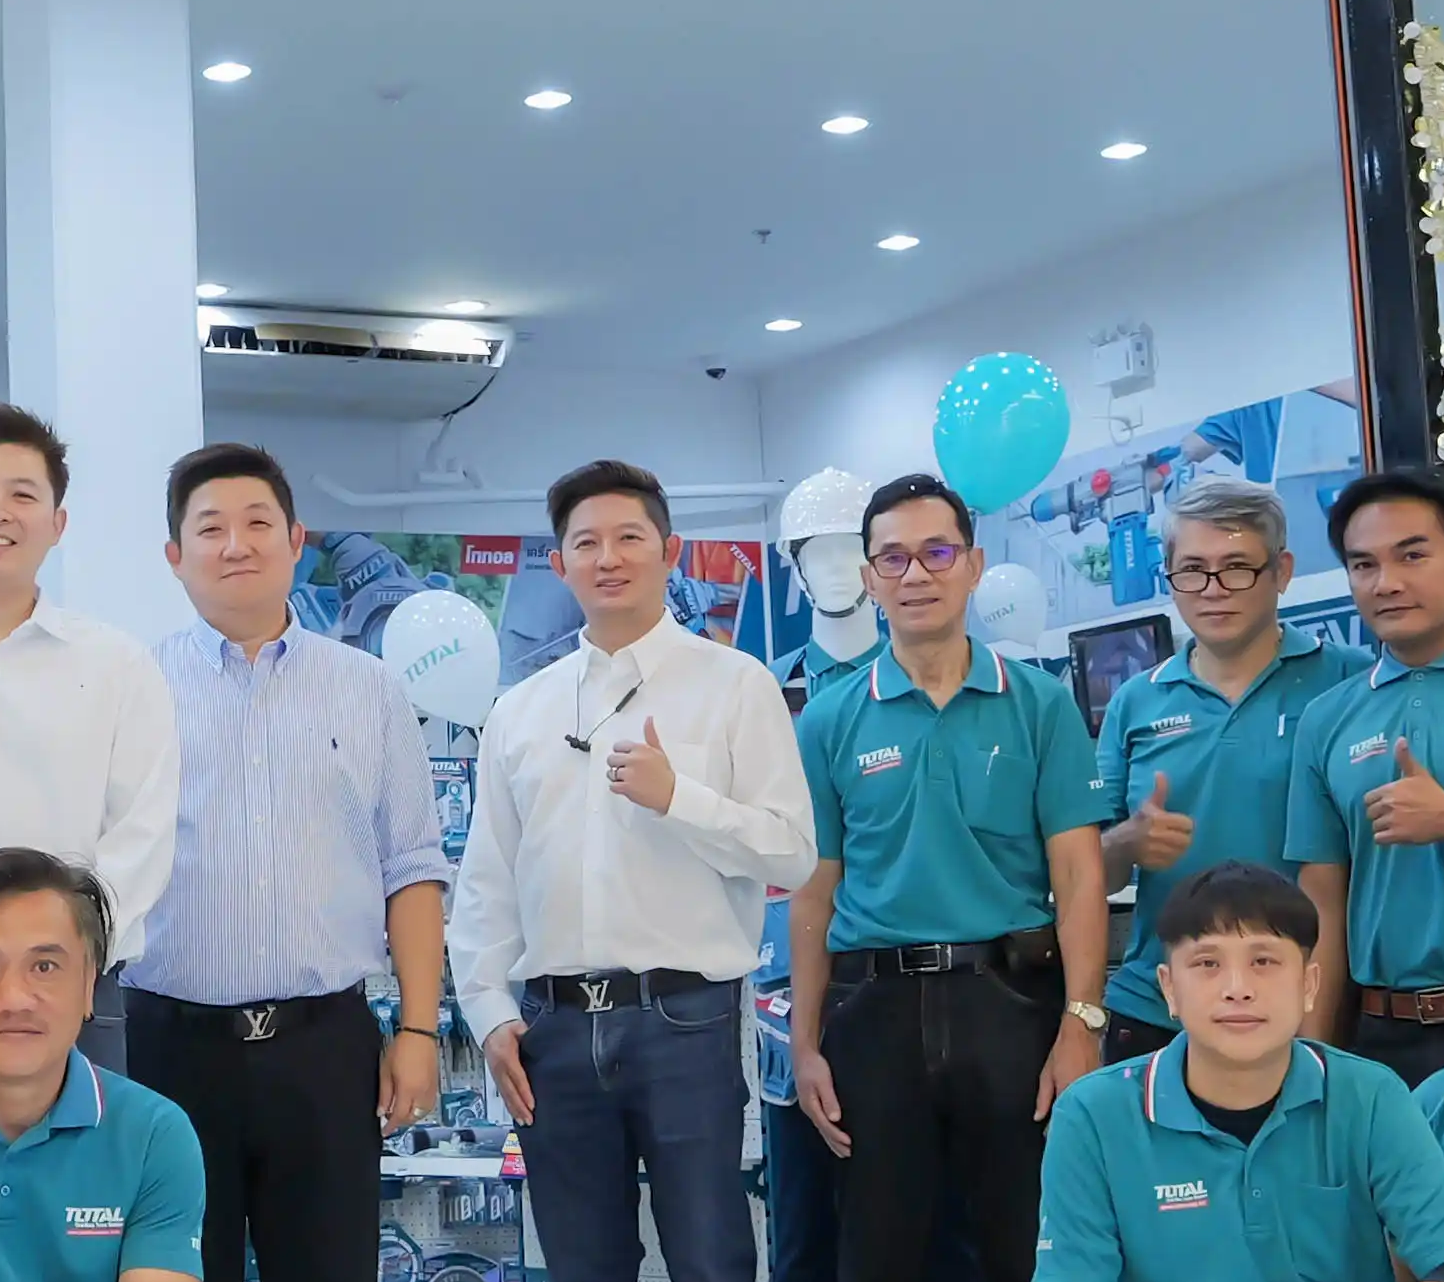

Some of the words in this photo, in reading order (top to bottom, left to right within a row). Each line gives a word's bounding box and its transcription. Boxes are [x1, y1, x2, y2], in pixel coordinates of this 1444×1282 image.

[466, 544, 514, 566] โททอล
[729, 544, 758, 574] TOTAL
[403, 638, 464, 683] TOTAL
[857, 745, 901, 767] TOTAL
[1154, 1181, 1208, 1200] TOTAL
[65, 1207, 124, 1222] TOTAL
